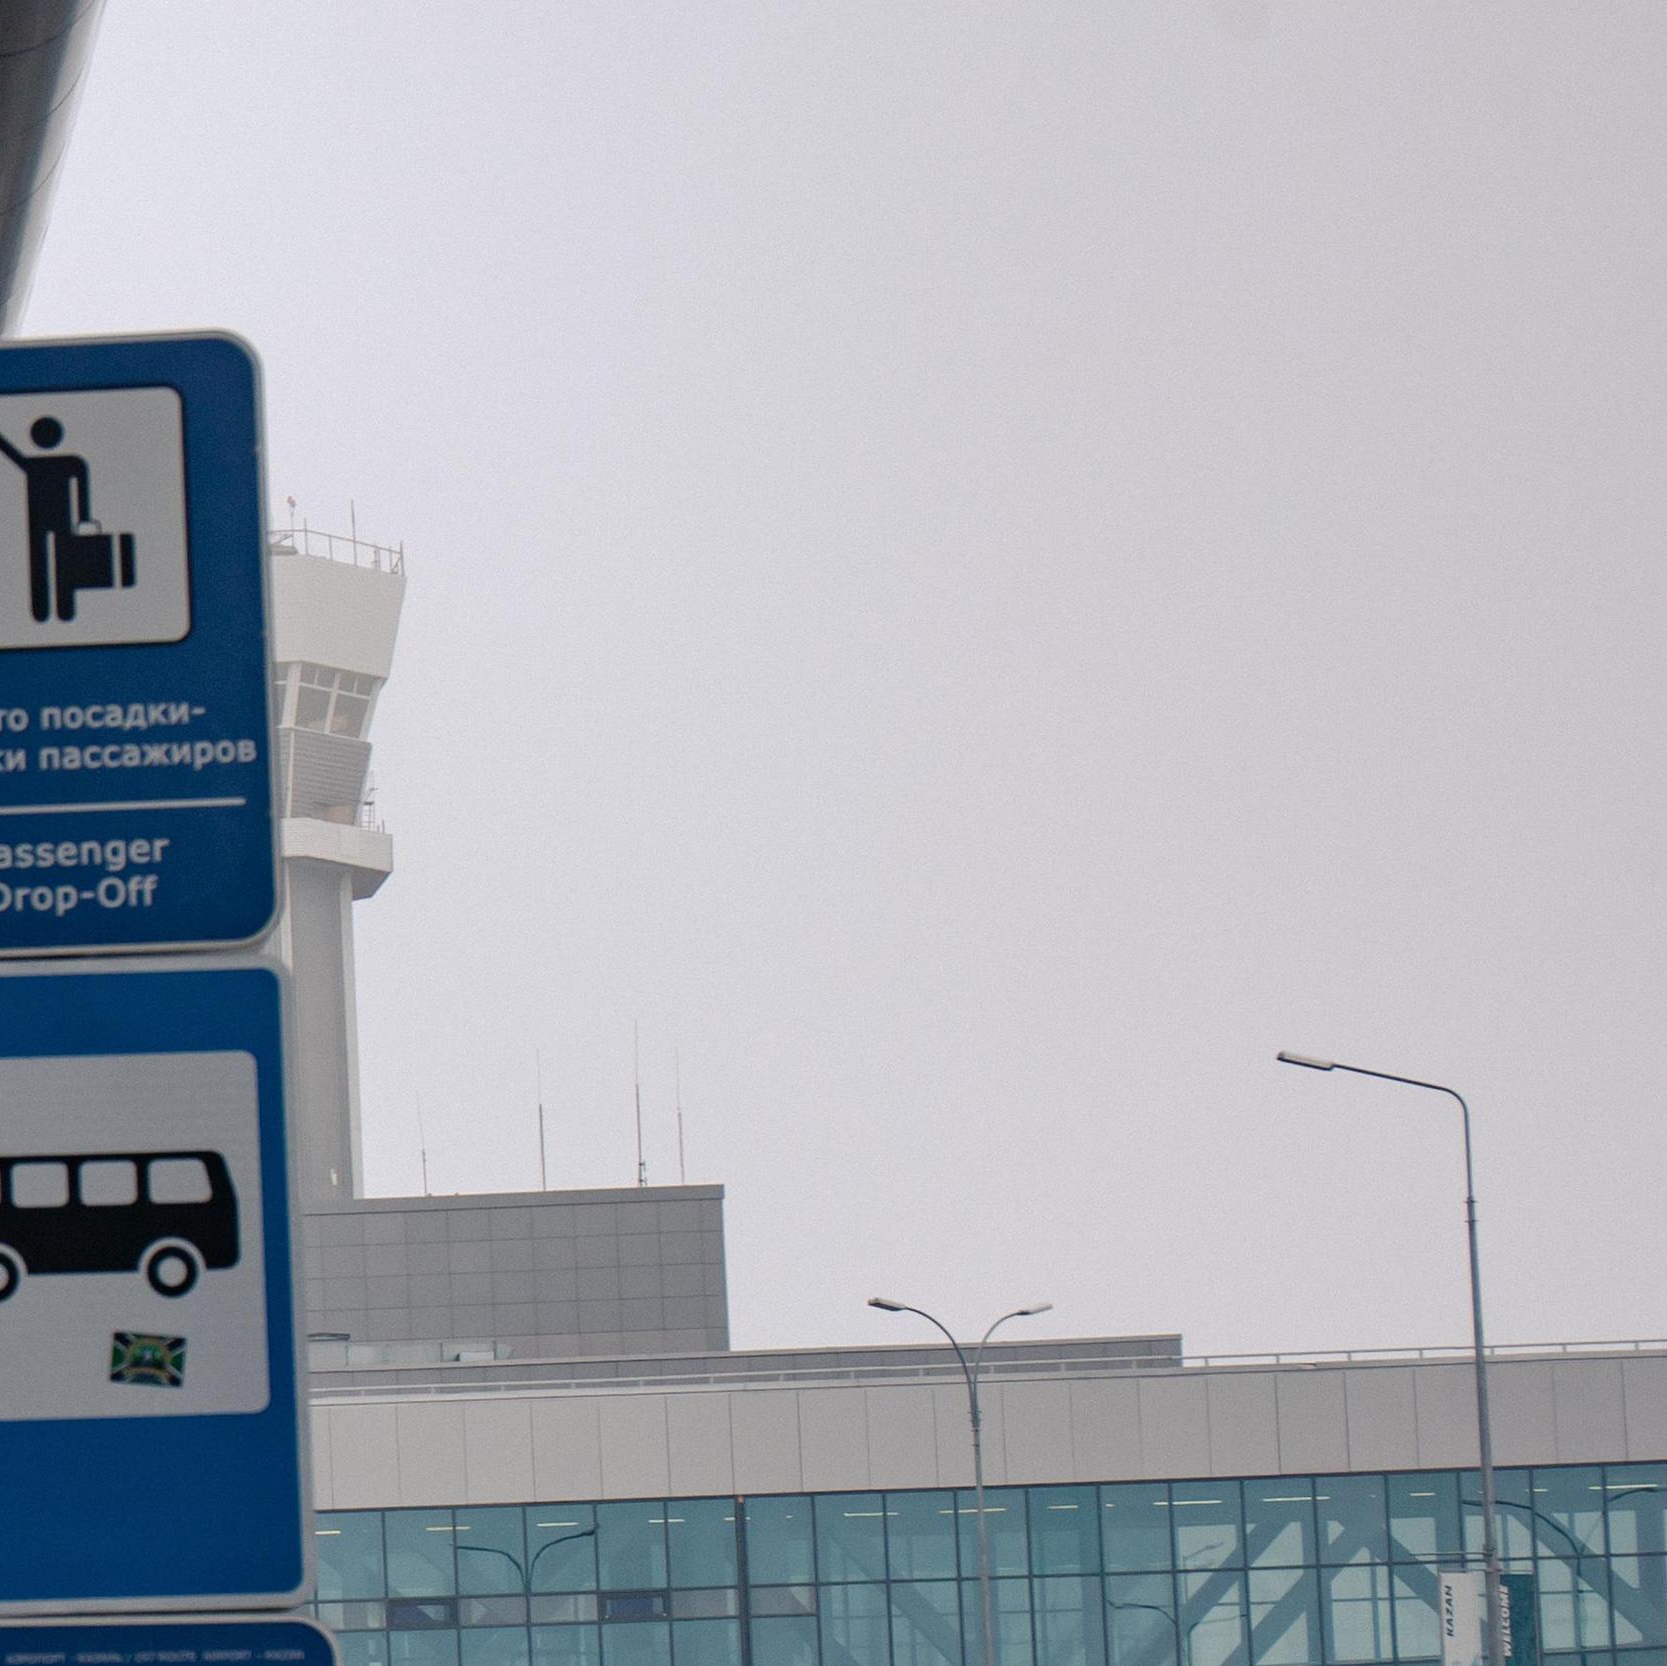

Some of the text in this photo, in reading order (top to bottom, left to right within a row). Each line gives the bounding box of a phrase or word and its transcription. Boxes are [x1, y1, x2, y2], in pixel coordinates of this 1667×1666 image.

[40, 702, 206, 731] посадки-
[39, 738, 257, 772] пассажиров
[1444, 1585, 1454, 1636] KAZAN
